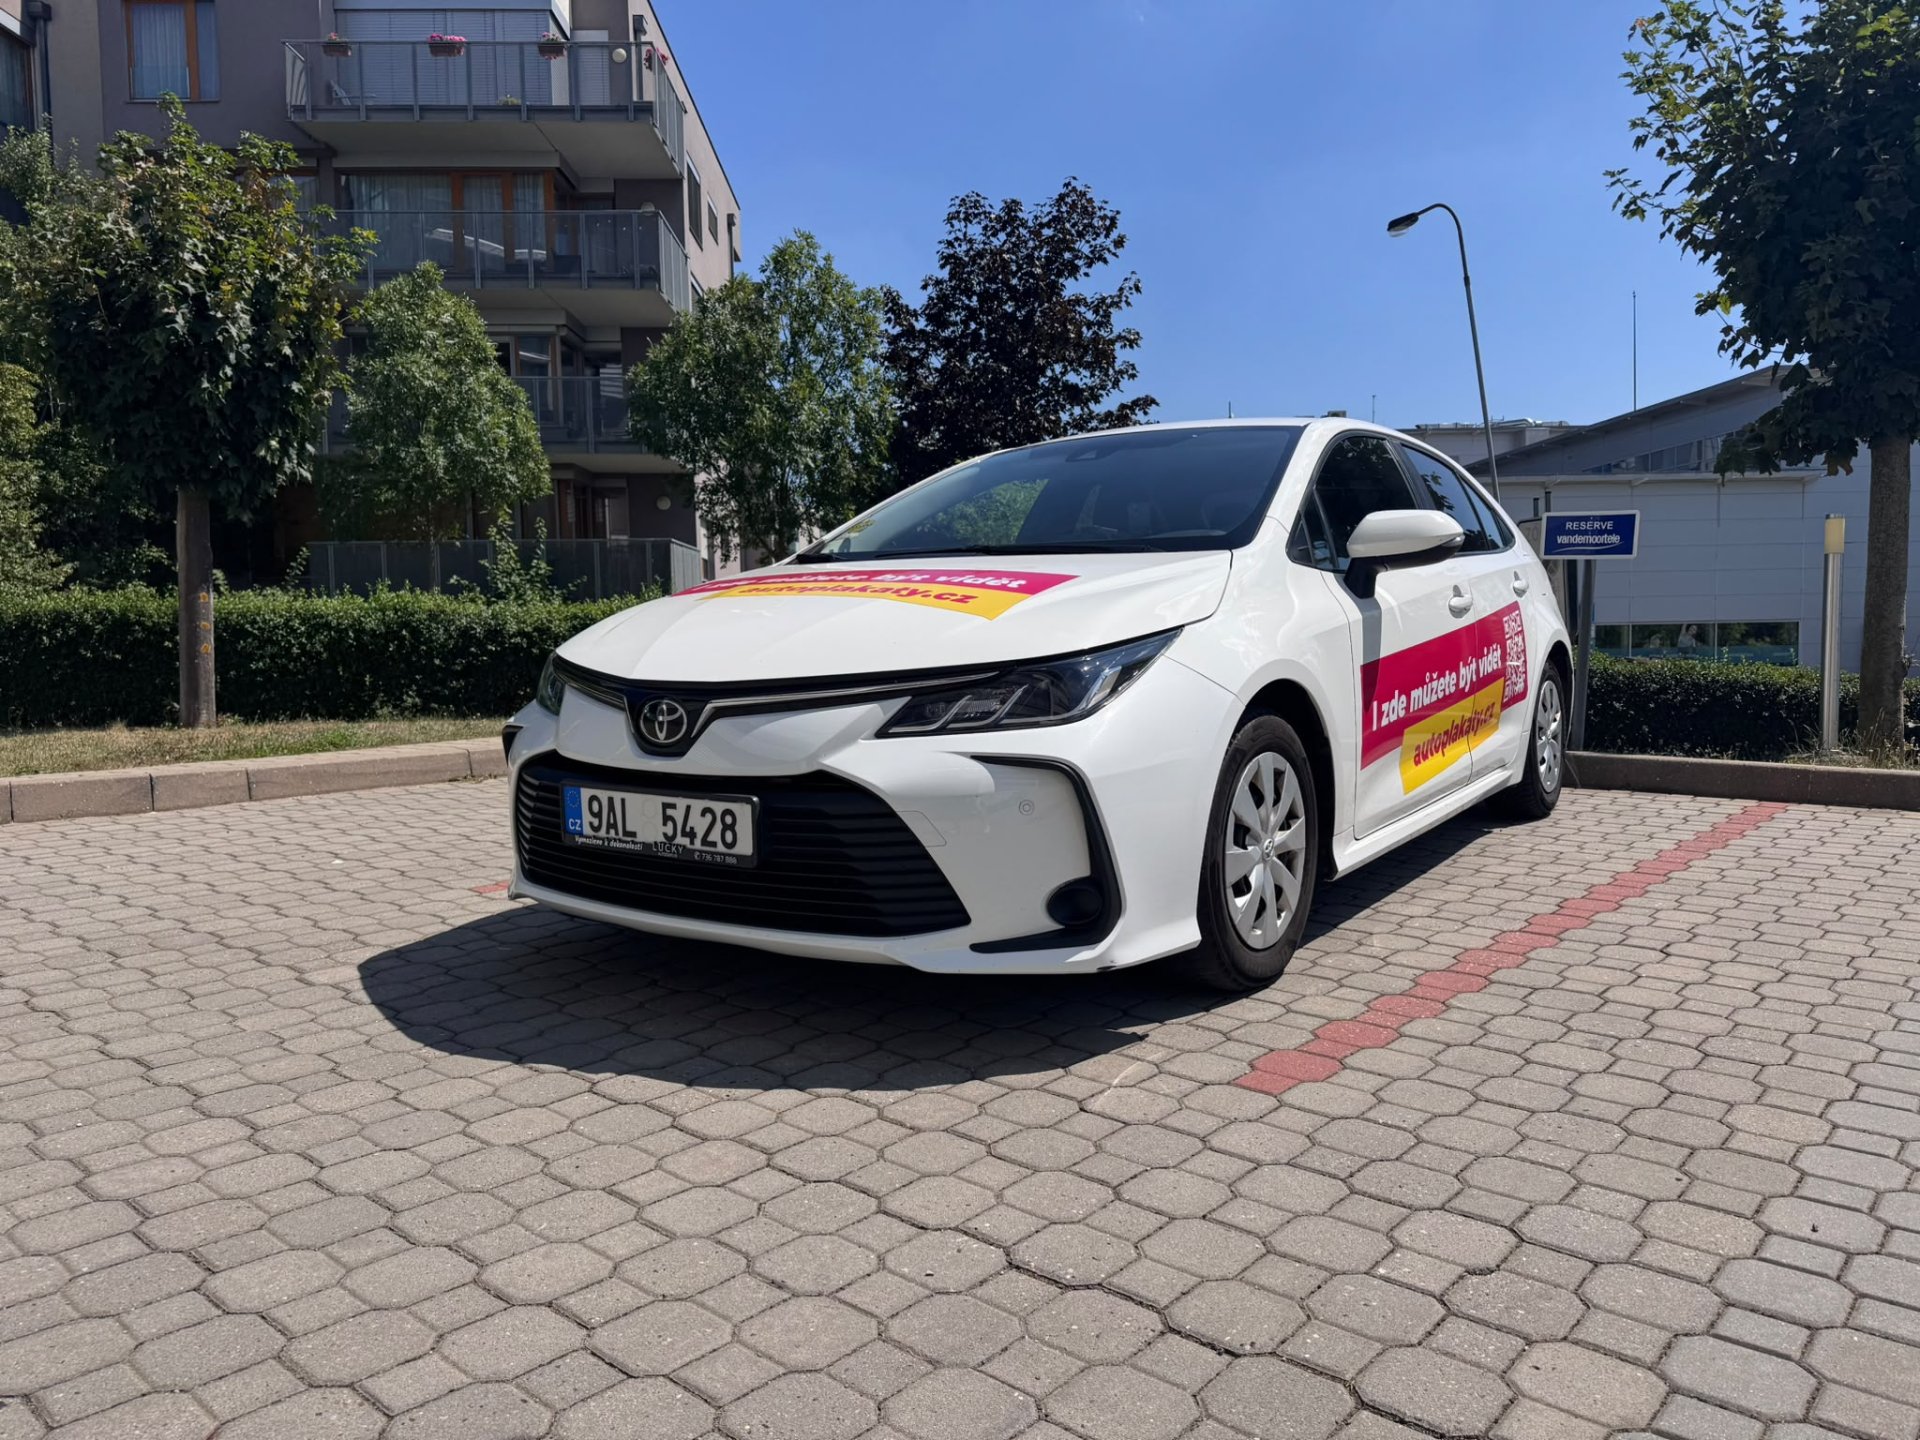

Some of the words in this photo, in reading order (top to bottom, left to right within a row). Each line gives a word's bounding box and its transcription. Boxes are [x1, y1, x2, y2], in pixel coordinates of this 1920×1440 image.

[1565, 520, 1614, 531] RESERVE
[1556, 533, 1621, 545] vandemoortele
[738, 583, 979, 604] autoplakaty.cz
[1372, 701, 1378, 732] I
[1381, 689, 1407, 728] zde
[1409, 670, 1457, 714] můžete
[1459, 656, 1477, 694] být
[1478, 644, 1503, 678] vidět
[1412, 701, 1497, 768] autoplakaty.cz
[568, 818, 582, 831] CZ
[587, 794, 638, 839] 9AL
[661, 801, 738, 850] 5428
[652, 842, 684, 854] LUCKY
